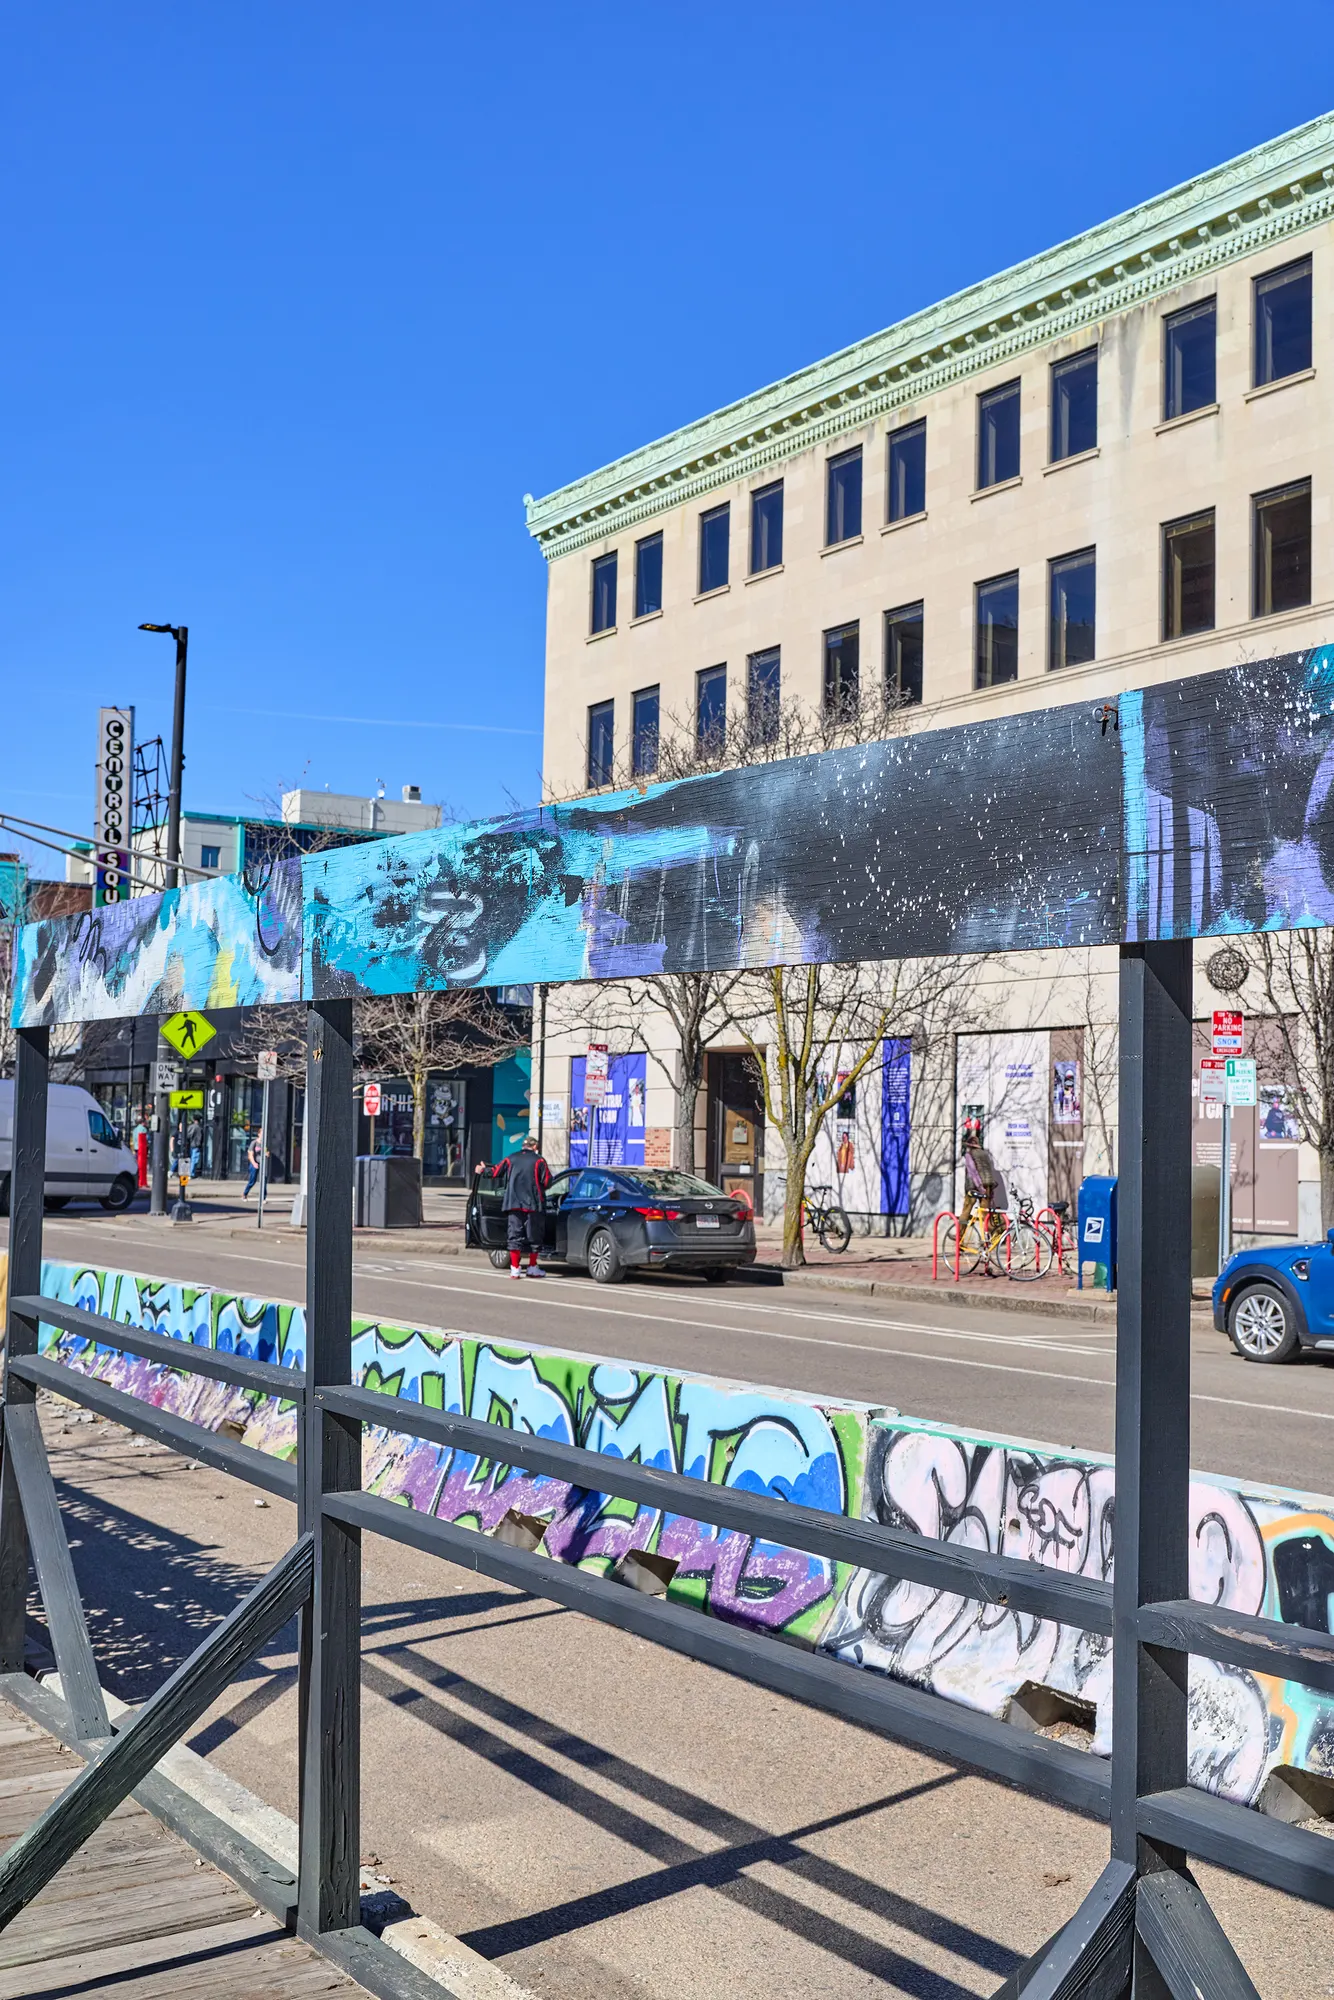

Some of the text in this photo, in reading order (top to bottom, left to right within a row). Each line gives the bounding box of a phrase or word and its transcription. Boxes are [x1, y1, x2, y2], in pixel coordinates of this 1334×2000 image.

[106, 720, 123, 846] CENTRAL
[1213, 1024, 1242, 1032] PARKING
[1229, 1062, 1233, 1075] 1
